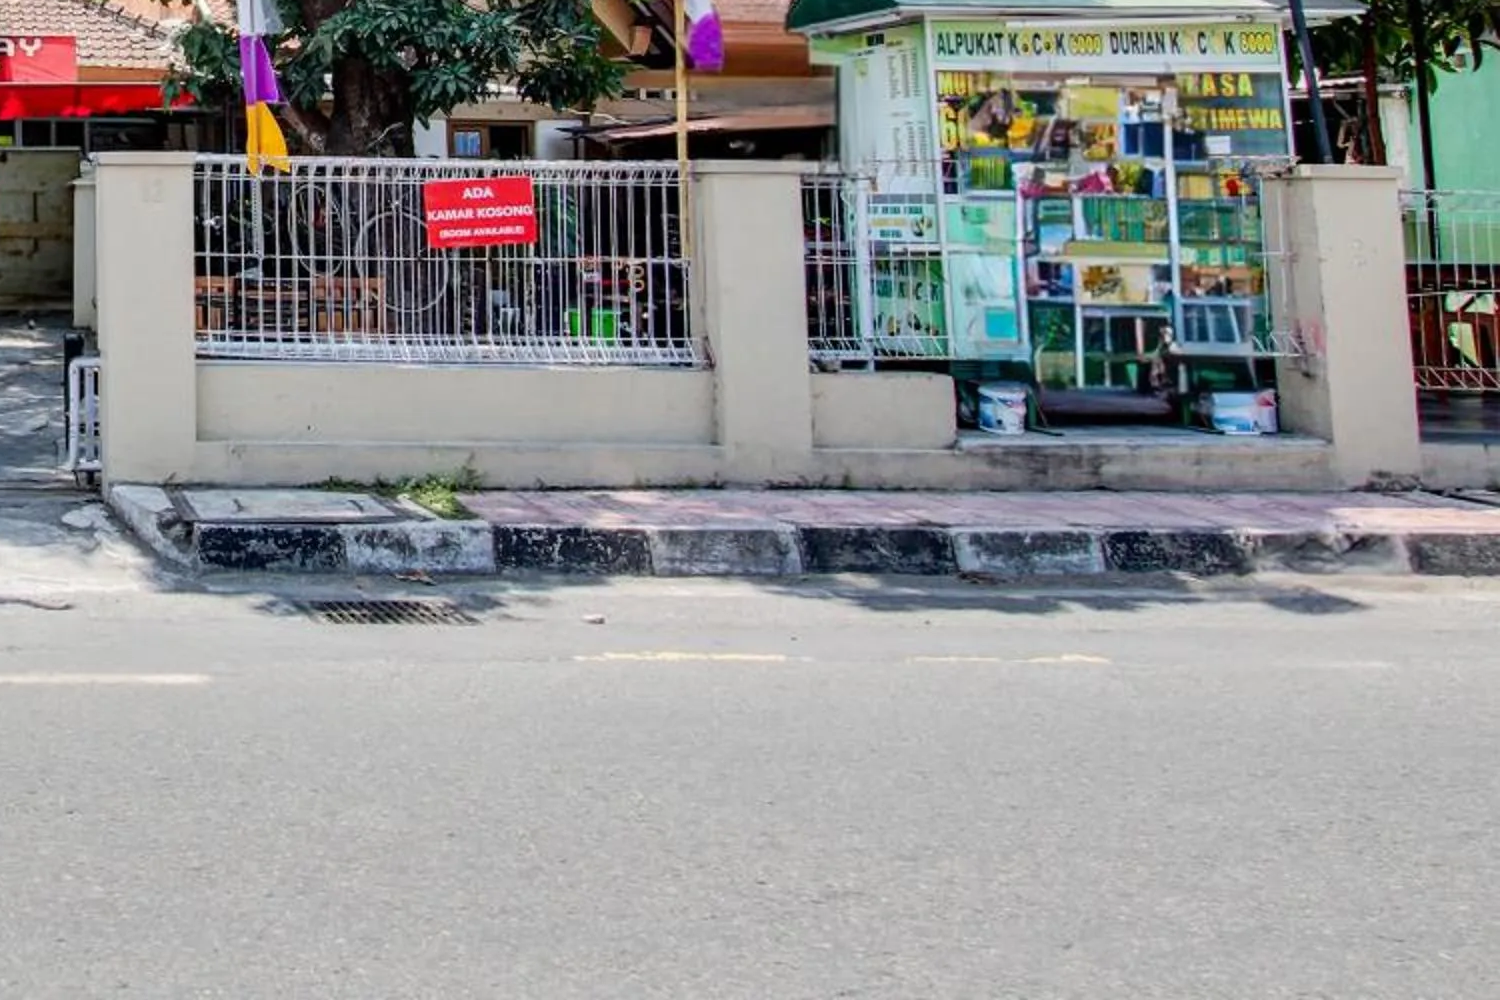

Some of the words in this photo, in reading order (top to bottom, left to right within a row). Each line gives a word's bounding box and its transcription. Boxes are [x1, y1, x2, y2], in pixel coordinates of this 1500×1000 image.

[937, 32, 1003, 56] ALPUKAT
[1109, 31, 1165, 55] DURIAN
[462, 187, 495, 200] ADA
[428, 208, 475, 221] KAMAR
[477, 204, 533, 219] KOSONG
